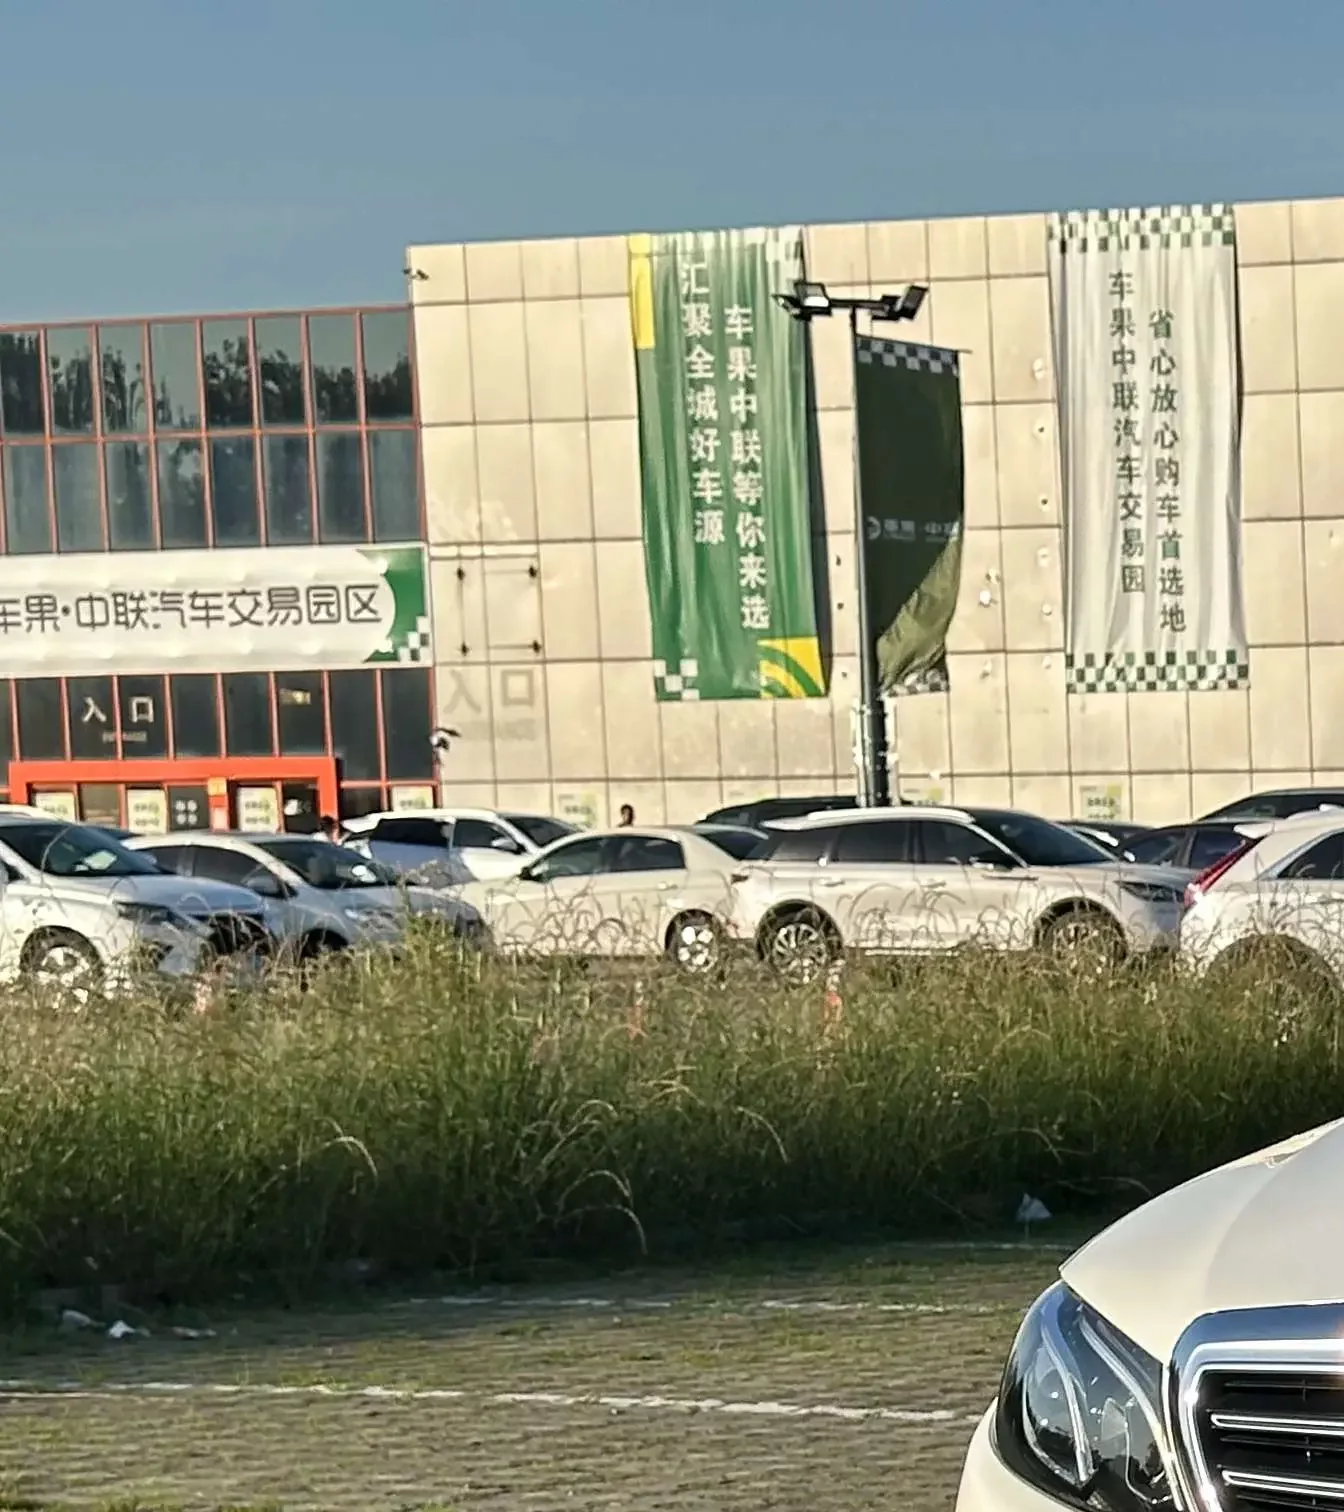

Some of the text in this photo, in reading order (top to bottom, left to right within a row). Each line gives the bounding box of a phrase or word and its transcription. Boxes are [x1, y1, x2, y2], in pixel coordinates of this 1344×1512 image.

[681, 262, 726, 546] 汇聚全城好车源
[724, 304, 770, 631] 车果中联等你来选
[1108, 270, 1146, 594] 车果中联汽车交易园
[1148, 309, 1187, 633] 省心放心购车首选地
[82, 696, 155, 723] 入口
